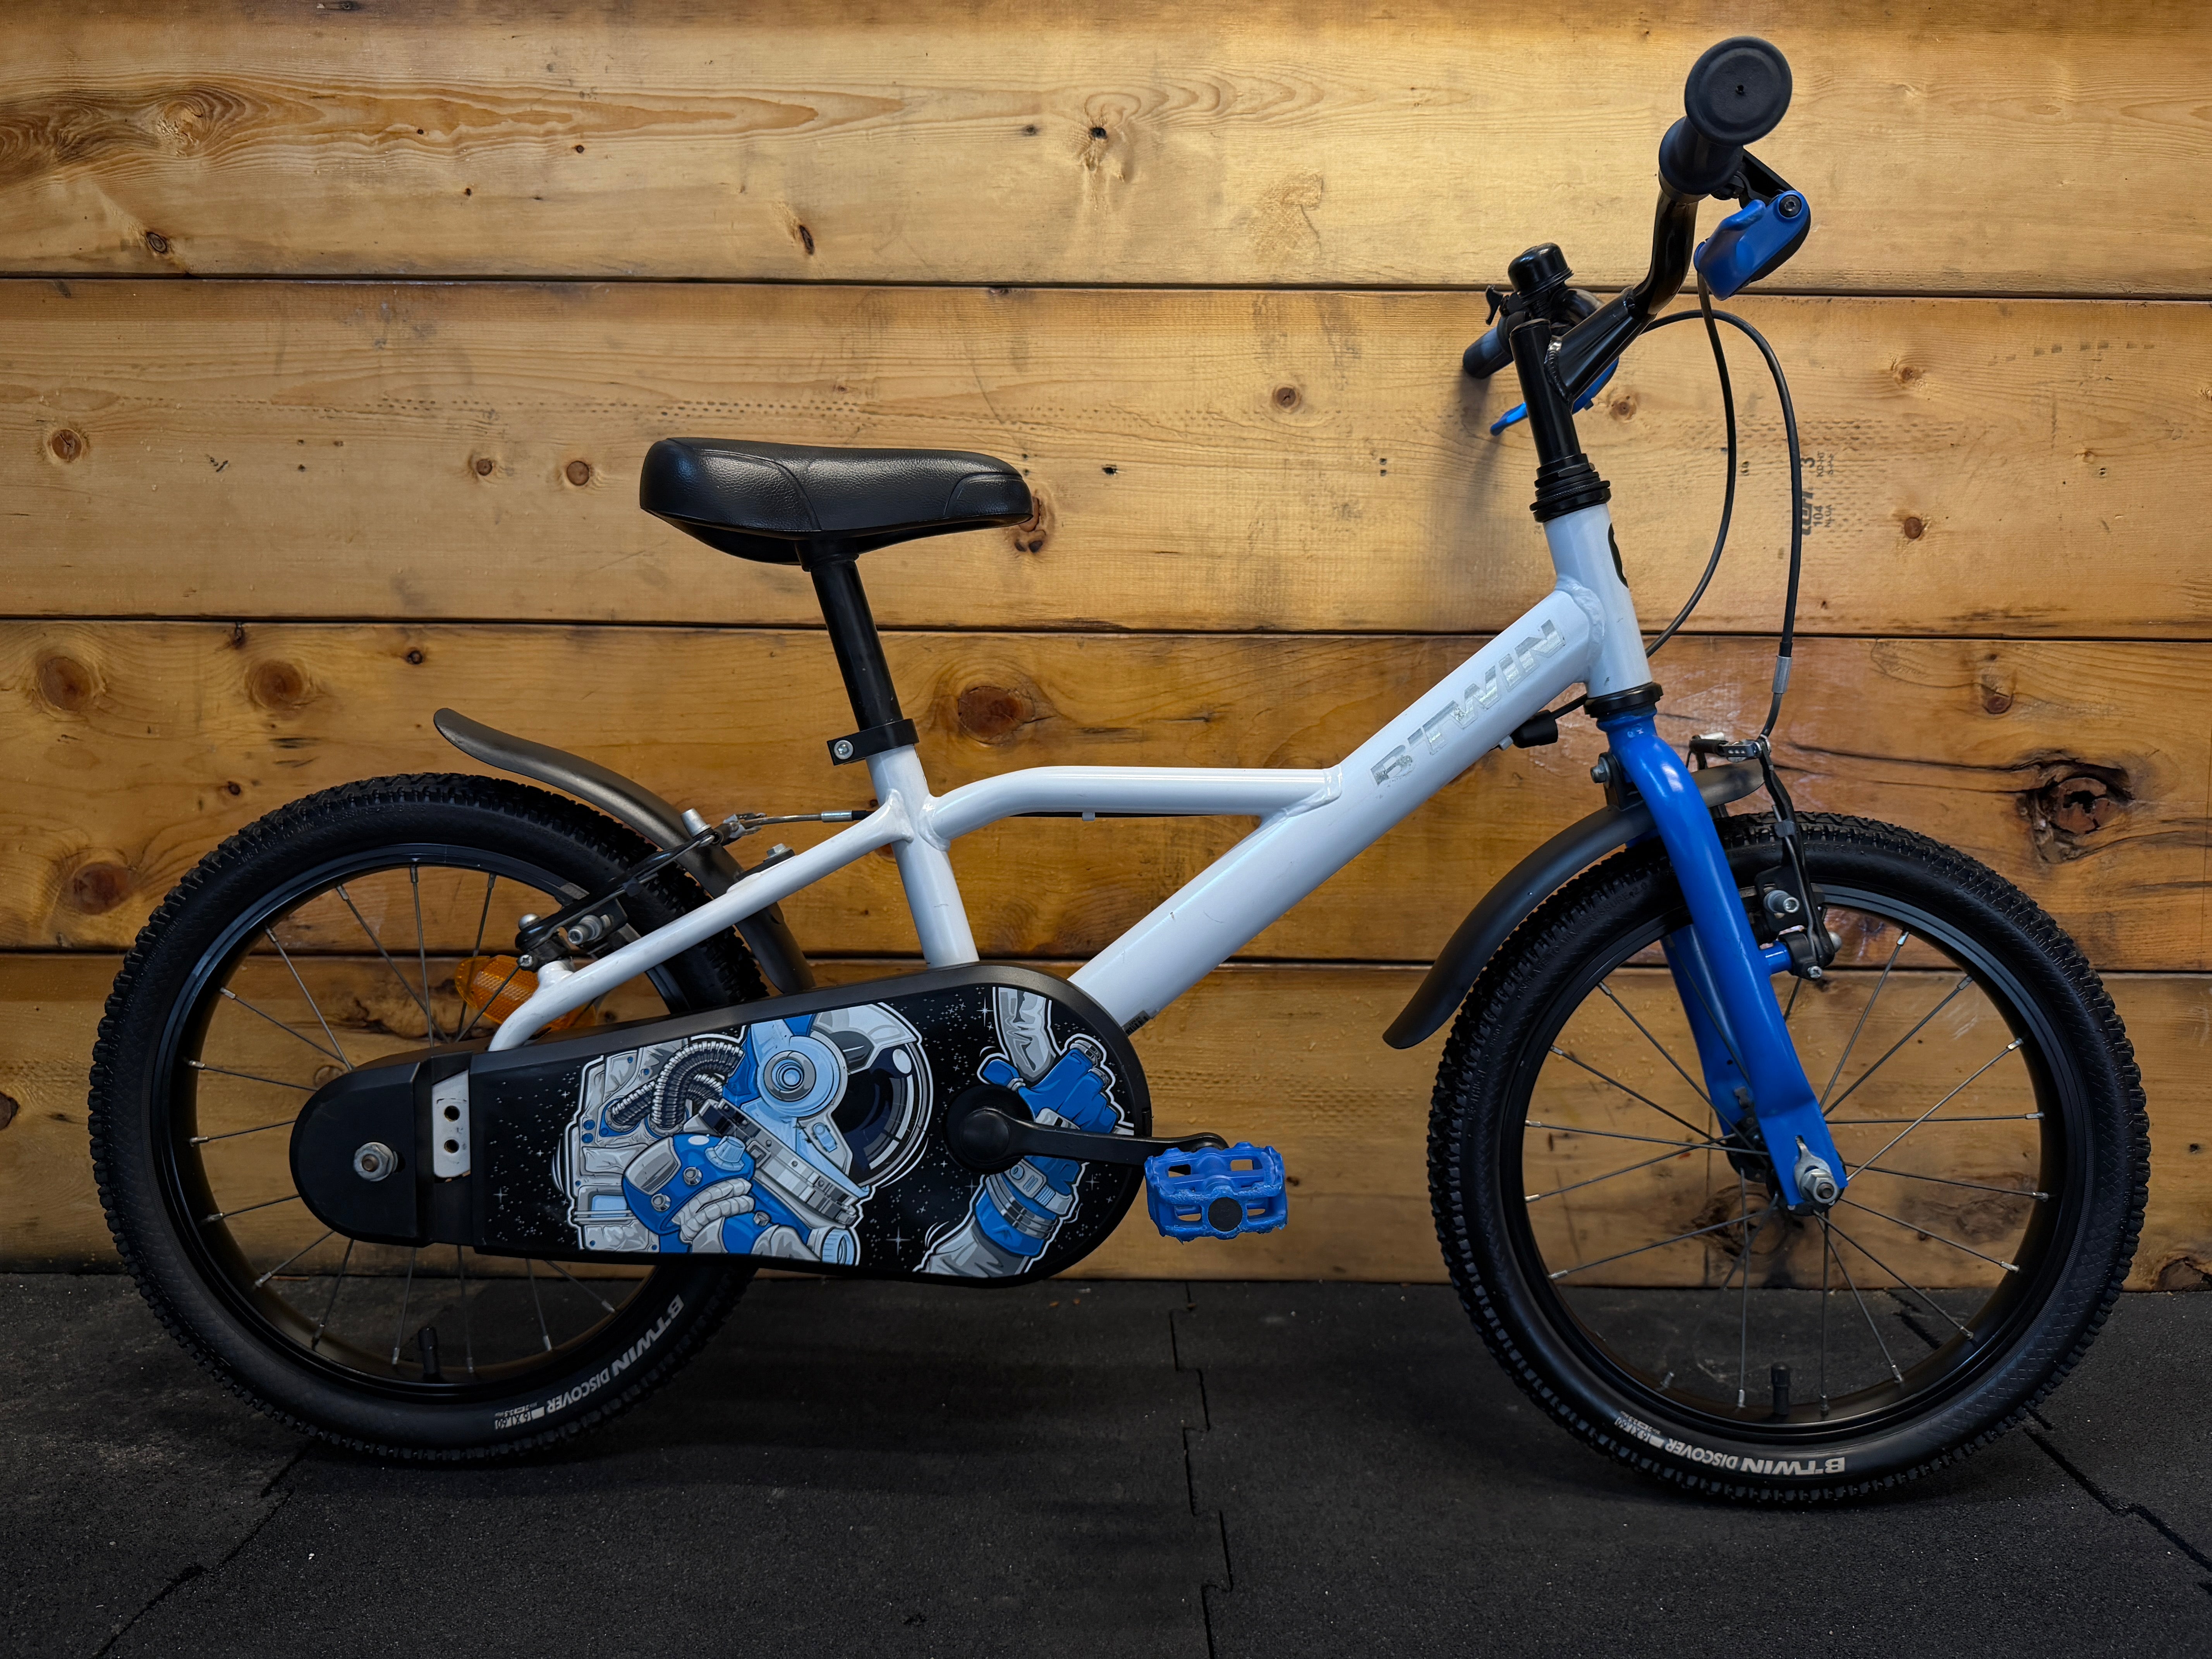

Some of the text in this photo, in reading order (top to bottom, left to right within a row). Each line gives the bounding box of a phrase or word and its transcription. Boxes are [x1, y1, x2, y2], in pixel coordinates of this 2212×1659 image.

[1816, 451, 1824, 477] KD-HT
[1813, 505, 1823, 527] 104
[546, 1369, 610, 1414] DISCOVER
[1664, 1438, 1739, 1469] DISCOVER
